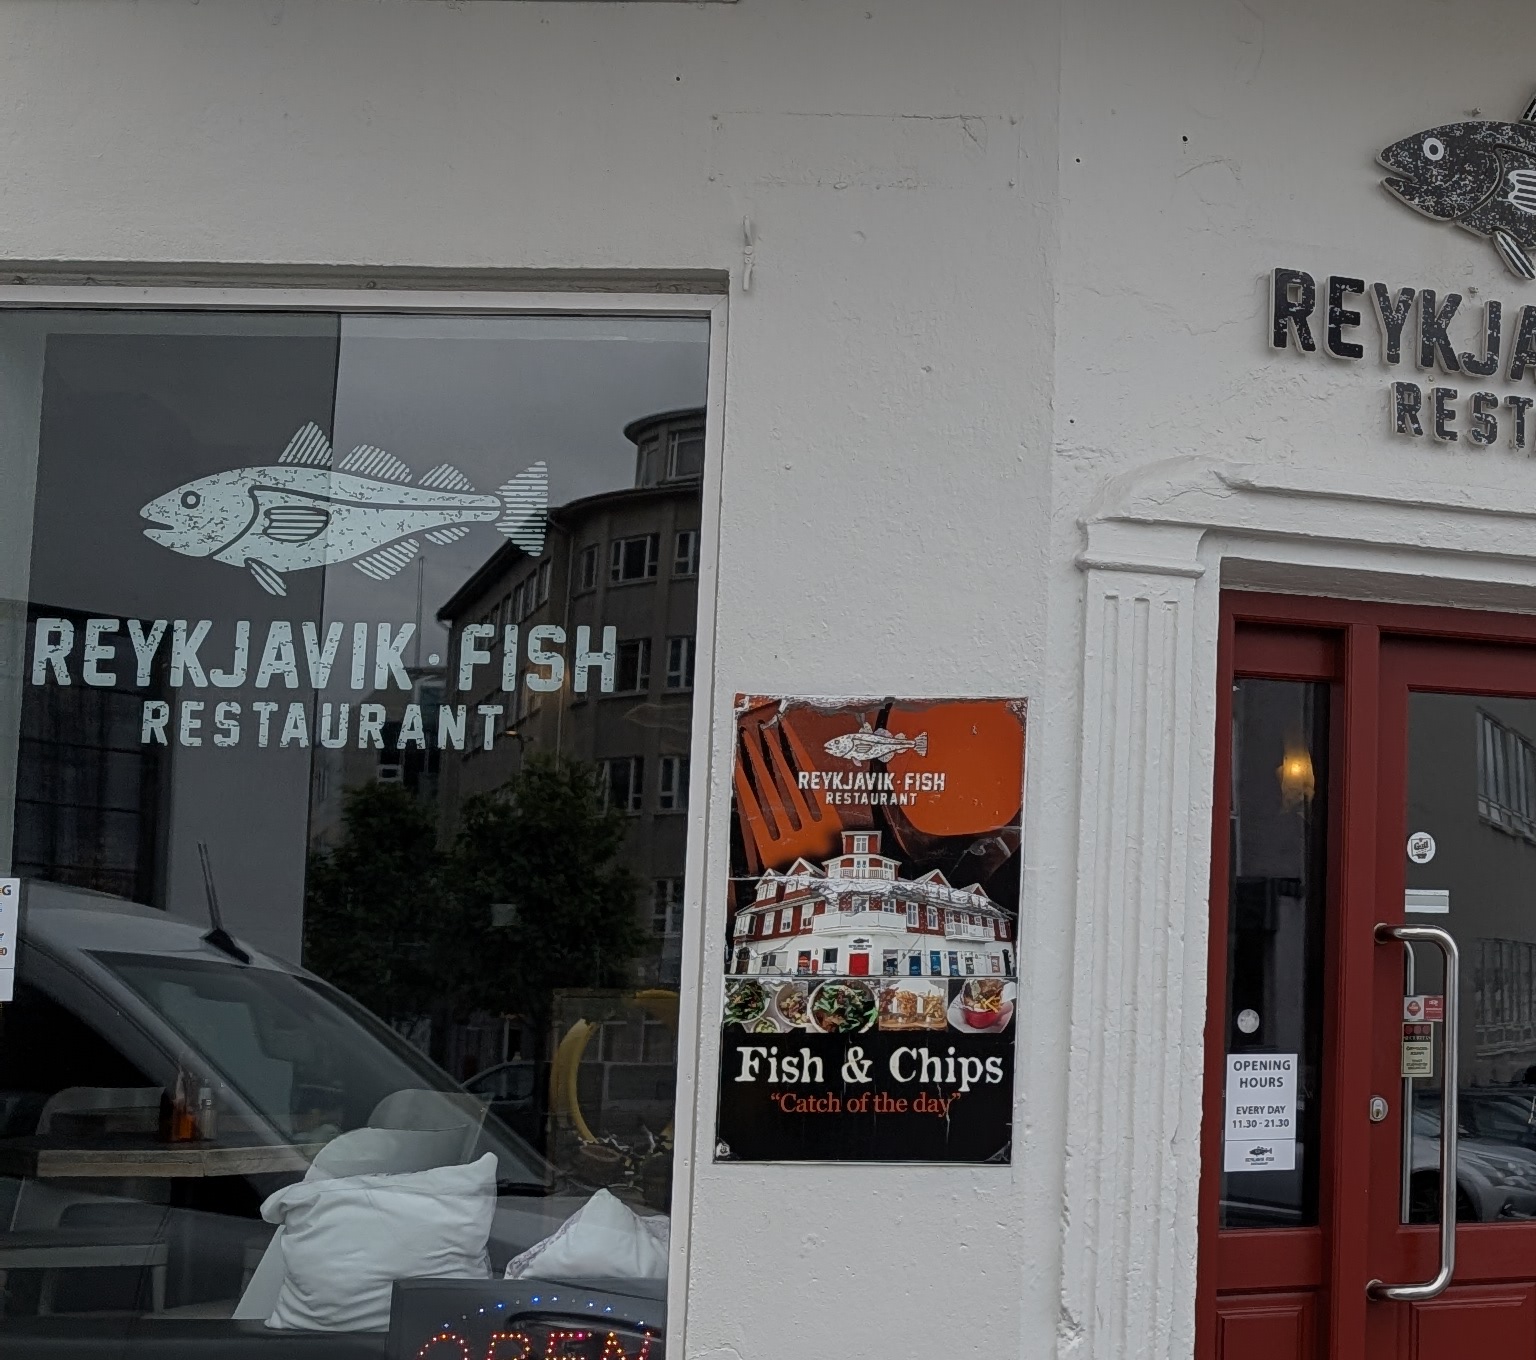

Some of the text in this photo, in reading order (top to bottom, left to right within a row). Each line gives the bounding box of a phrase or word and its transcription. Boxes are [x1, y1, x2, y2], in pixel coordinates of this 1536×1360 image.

[31, 617, 617, 693] REYKJAVIK FISH
[141, 700, 503, 750] RESTAURANT
[798, 771, 945, 792] REYKJAVIK FISH
[825, 791, 917, 806] RESTAURANT
[735, 1046, 1004, 1092] Fish & Chips
[1233, 1060, 1291, 1071] OPENING
[1240, 1077, 1284, 1088] HOURS
[846, 1092, 871, 1113] of
[875, 1092, 907, 1113] the
[1236, 1105, 1286, 1115] EVERY DAY
